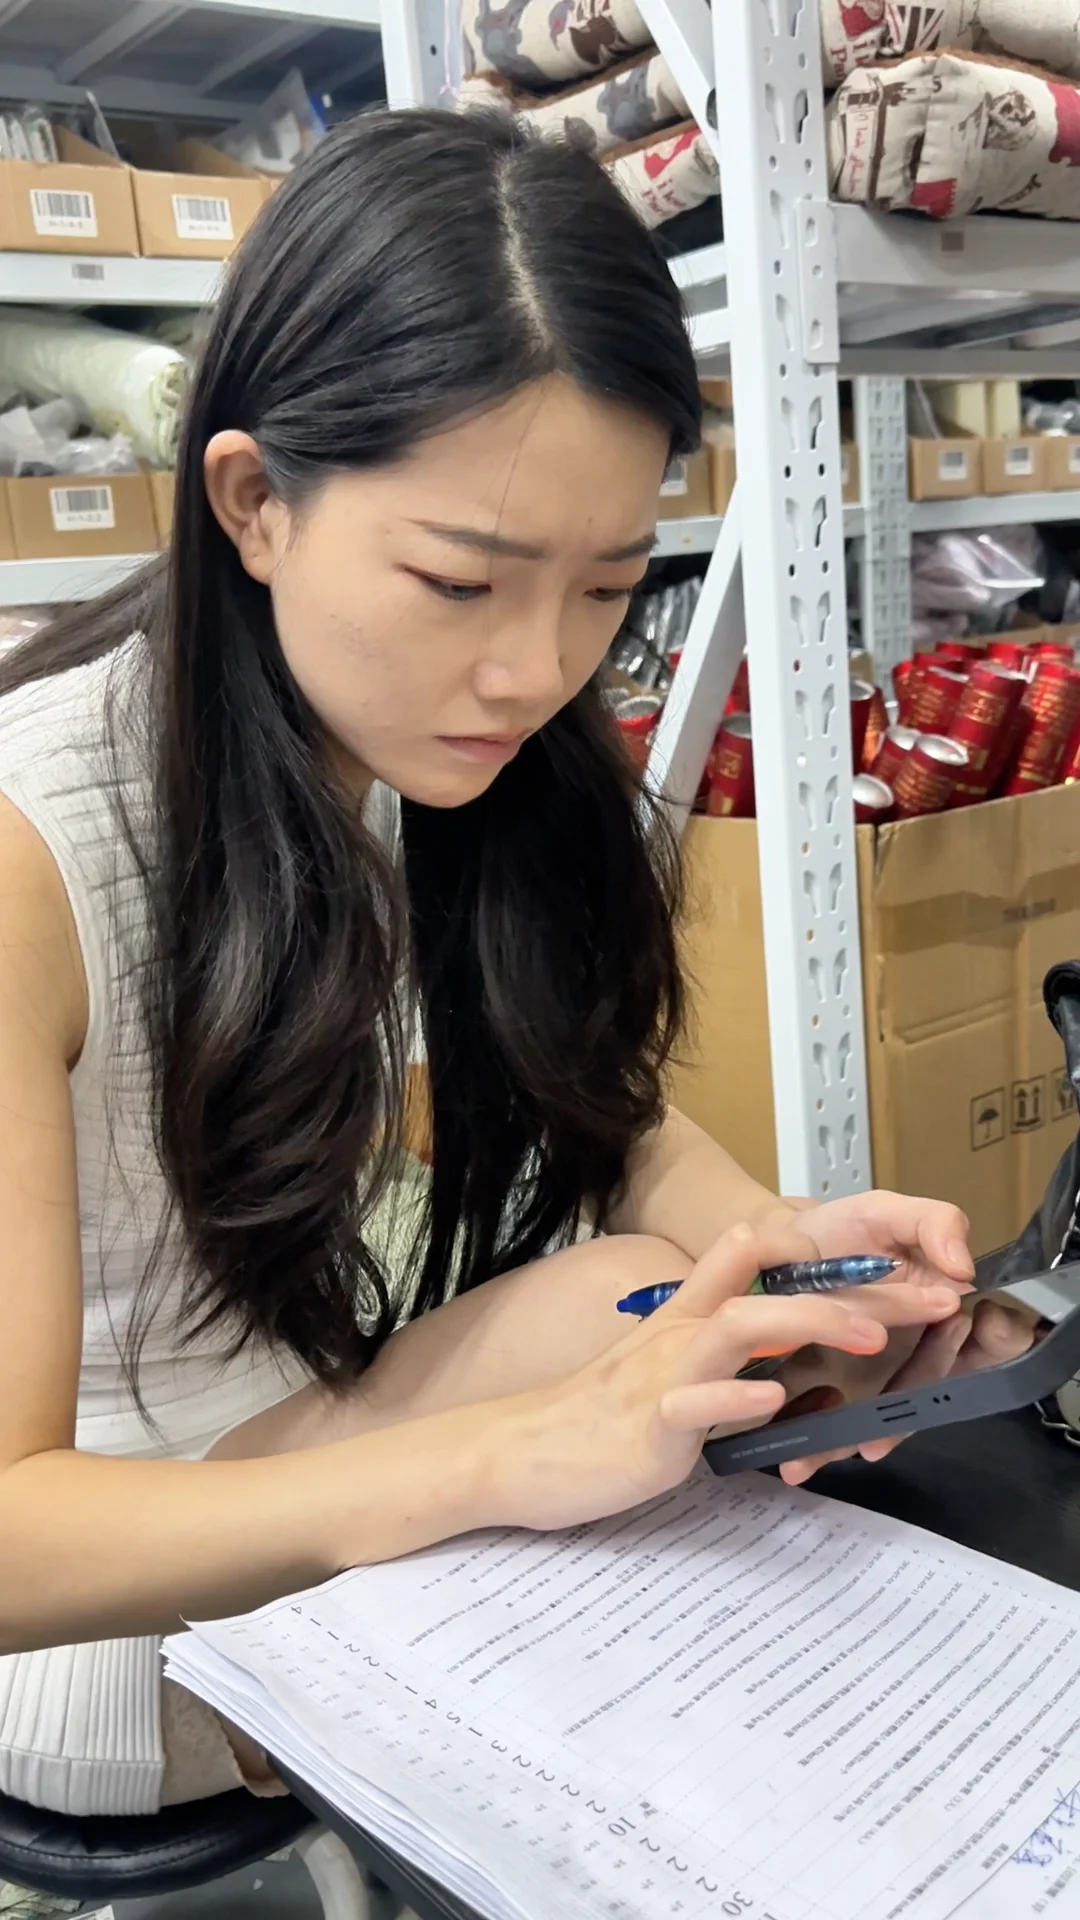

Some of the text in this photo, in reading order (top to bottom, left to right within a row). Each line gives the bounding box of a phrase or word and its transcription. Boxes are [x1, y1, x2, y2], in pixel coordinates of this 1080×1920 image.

[290, 1605, 301, 1616] 4
[309, 1617, 321, 1626] 1
[327, 1630, 339, 1641] 1
[343, 1643, 359, 1652] 2
[362, 1656, 379, 1666] 2
[384, 1671, 397, 1681] 1
[404, 1685, 418, 1694] 1
[423, 1699, 436, 1709] 4
[446, 1710, 459, 1724] 5
[467, 1726, 483, 1737] 1
[490, 1739, 507, 1752] 3
[511, 1754, 530, 1766] 2
[534, 1768, 554, 1780] 2
[559, 1783, 579, 1795] 2
[584, 1799, 605, 1812] 2
[607, 1815, 636, 1836] 10
[639, 1837, 660, 1851] 2
[666, 1855, 687, 1871] 2
[695, 1875, 717, 1891] 2
[722, 1891, 753, 1915] 30
